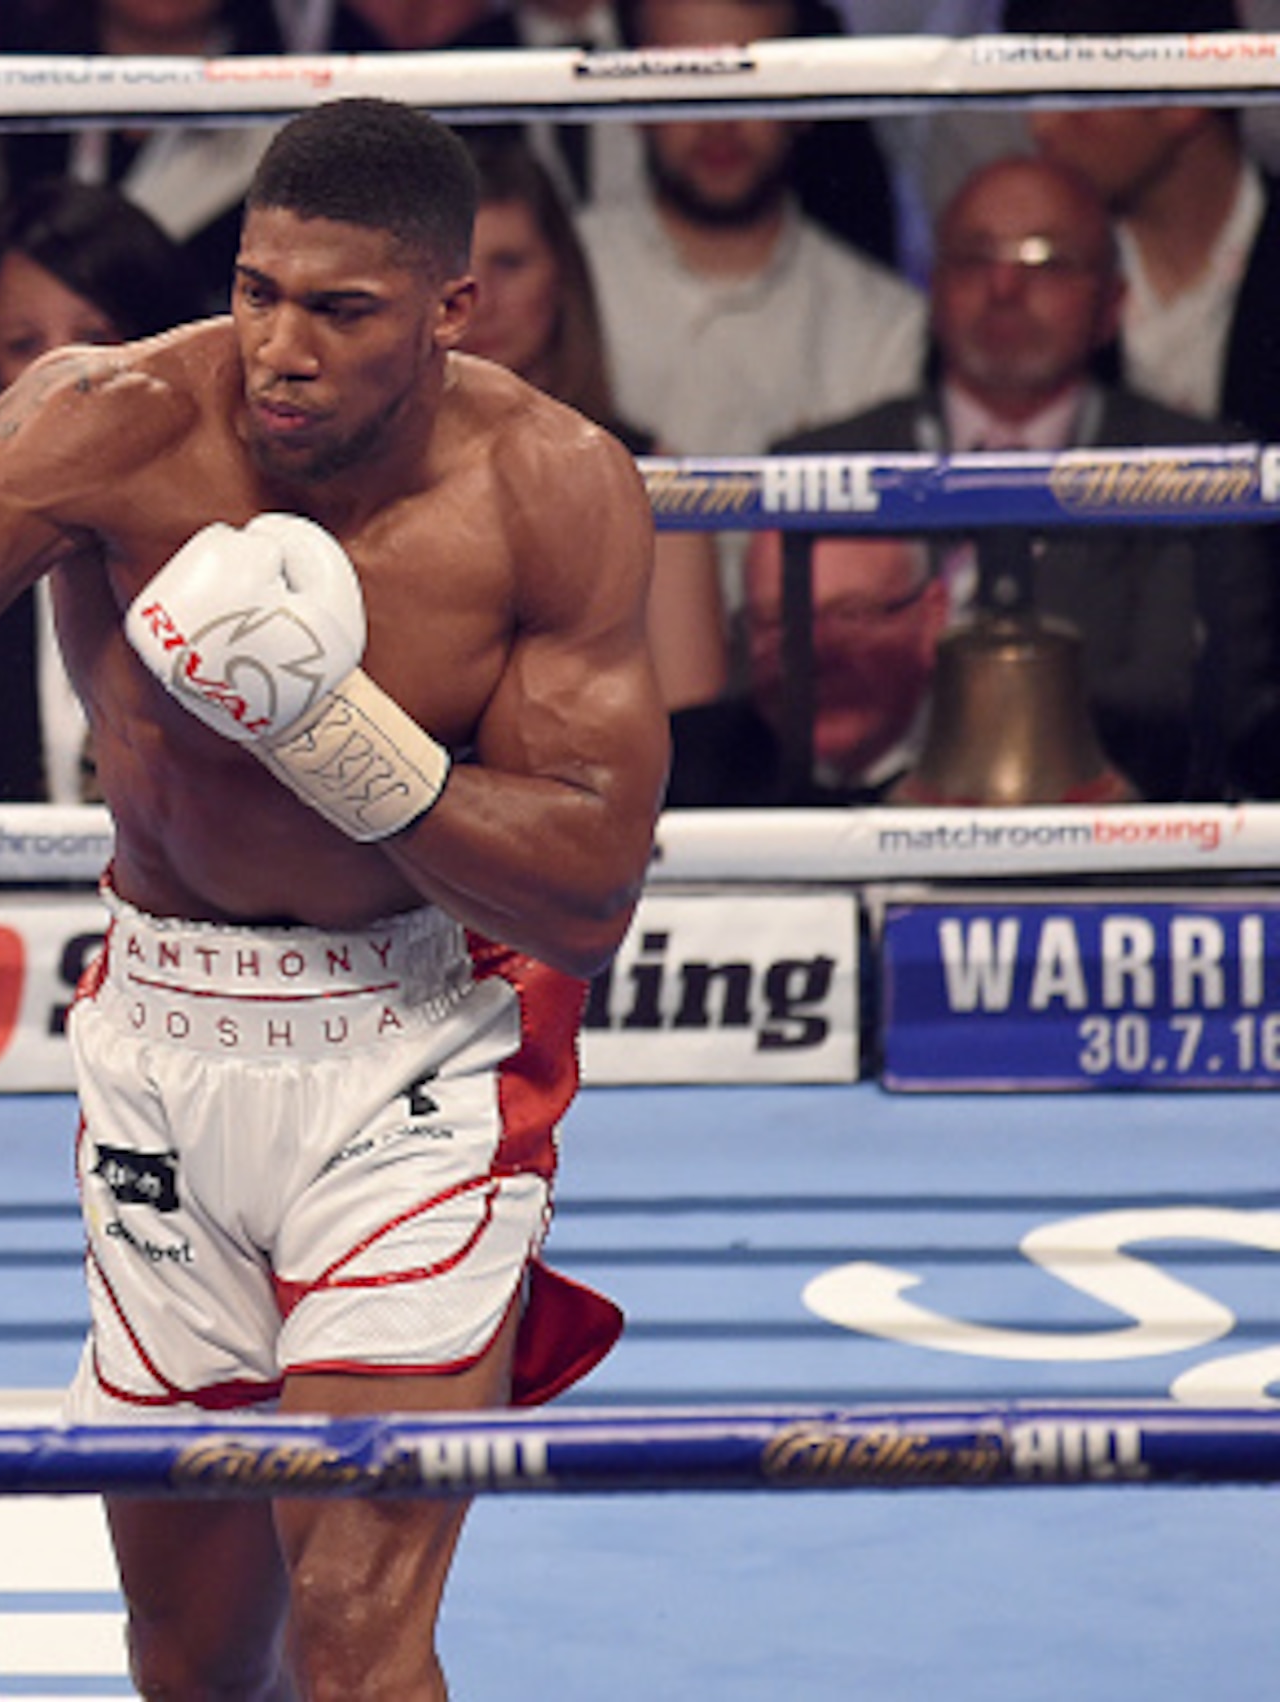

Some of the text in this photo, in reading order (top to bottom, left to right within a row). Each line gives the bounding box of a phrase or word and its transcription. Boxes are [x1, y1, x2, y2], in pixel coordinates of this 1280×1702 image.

[763, 458, 882, 512] HILL
[140, 601, 272, 735] RIVAL
[879, 816, 1222, 852] matchroomboxing
[126, 935, 394, 978] ANTHONY
[128, 1001, 402, 1048] JOSHUA
[418, 1435, 551, 1486] HILL
[1013, 1424, 1149, 1481] HILL
